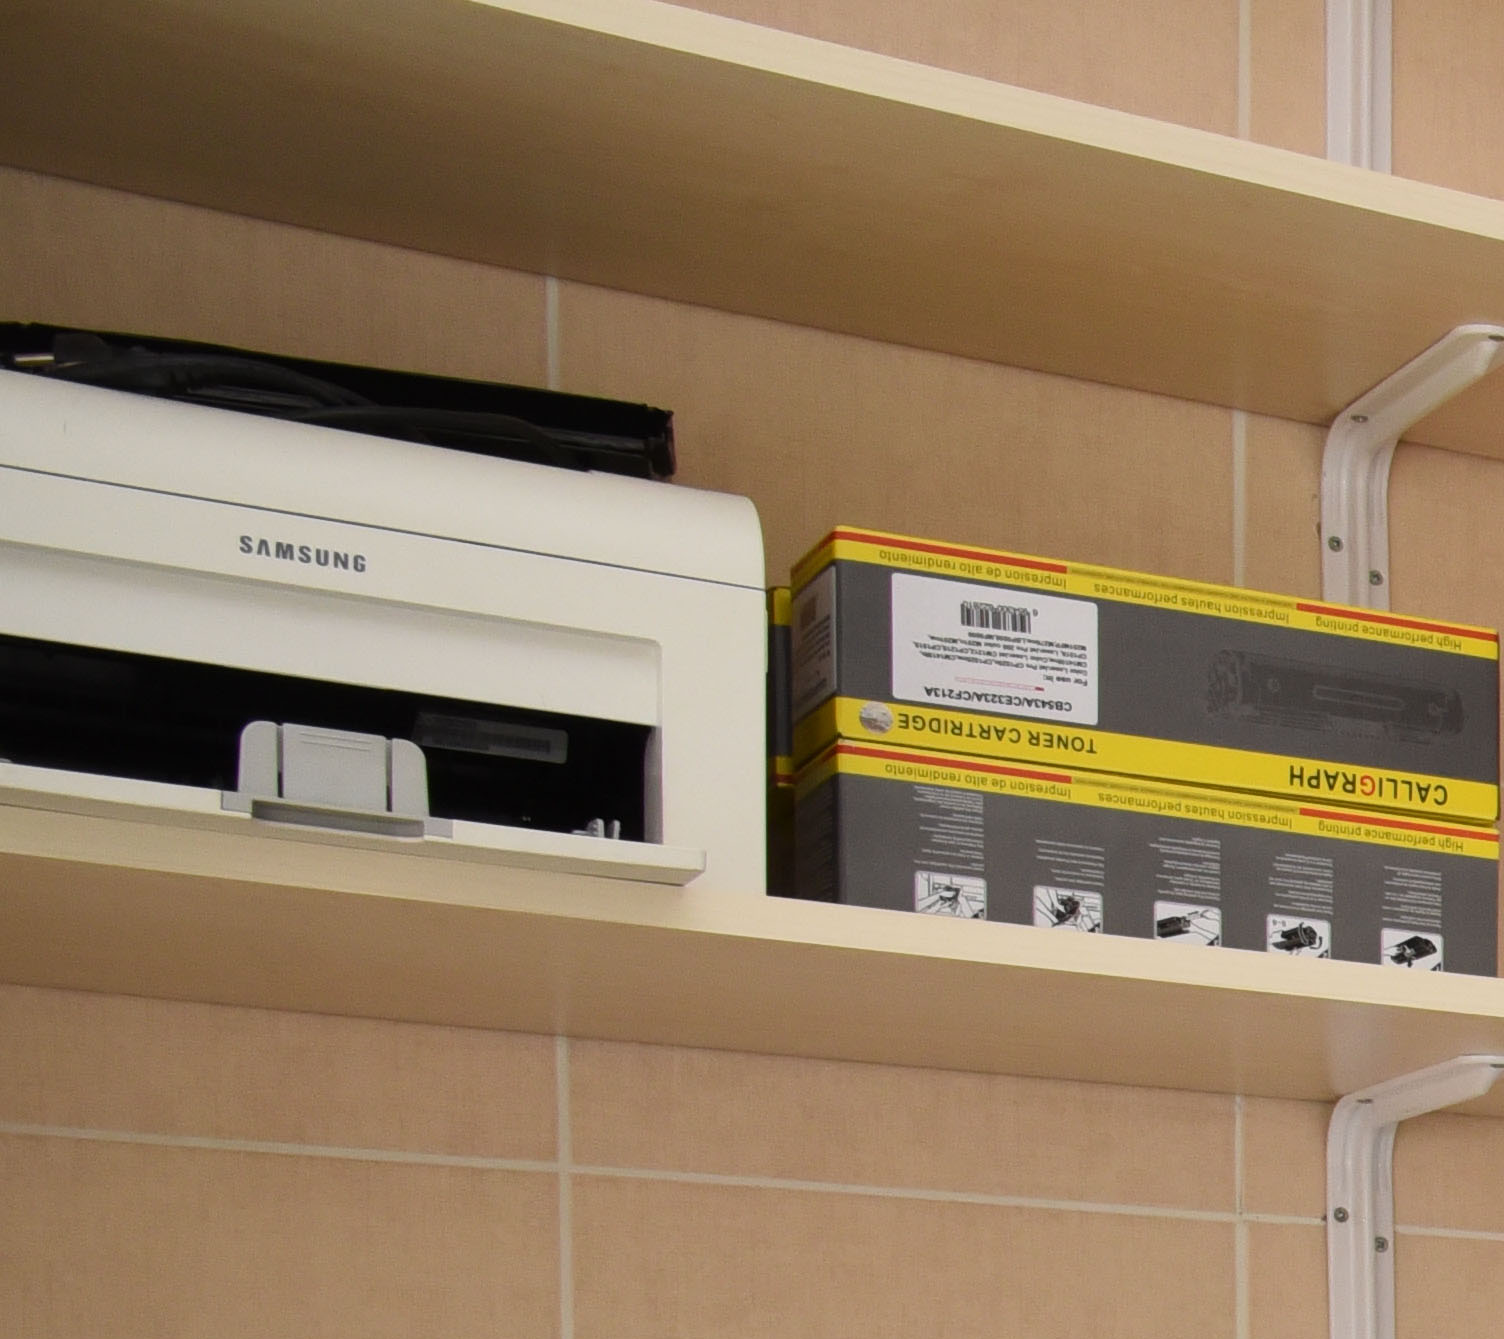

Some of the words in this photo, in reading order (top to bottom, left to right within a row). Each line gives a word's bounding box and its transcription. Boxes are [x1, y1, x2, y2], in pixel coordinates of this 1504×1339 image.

[239, 535, 367, 573] SAMSUNG
[879, 550, 956, 571] rendimiento
[959, 562, 983, 575] alto
[986, 567, 1001, 578] de
[1005, 568, 1067, 590] Impresion
[1094, 583, 1178, 605] performances
[1181, 595, 1222, 613] hautes
[1225, 603, 1289, 624] Impression
[1315, 615, 1359, 633] printing
[1362, 624, 1434, 645] performance
[1438, 635, 1462, 651] High
[924, 686, 1072, 712] CB543A/CE323A/CF213A
[897, 713, 1021, 744] CARTRIDGE
[1029, 731, 1098, 754] TONER
[885, 763, 962, 782] rendimiento
[965, 773, 988, 785] alto
[991, 777, 1006, 788] de
[1010, 781, 1072, 799] Impresion
[1289, 764, 1448, 806] CALLIGRAPH
[1098, 791, 1182, 814] performances
[1185, 804, 1225, 820] hautes
[1227, 808, 1293, 829] Impression
[1318, 820, 1362, 838] printing
[1364, 828, 1435, 847] performance
[1438, 836, 1464, 852] High
